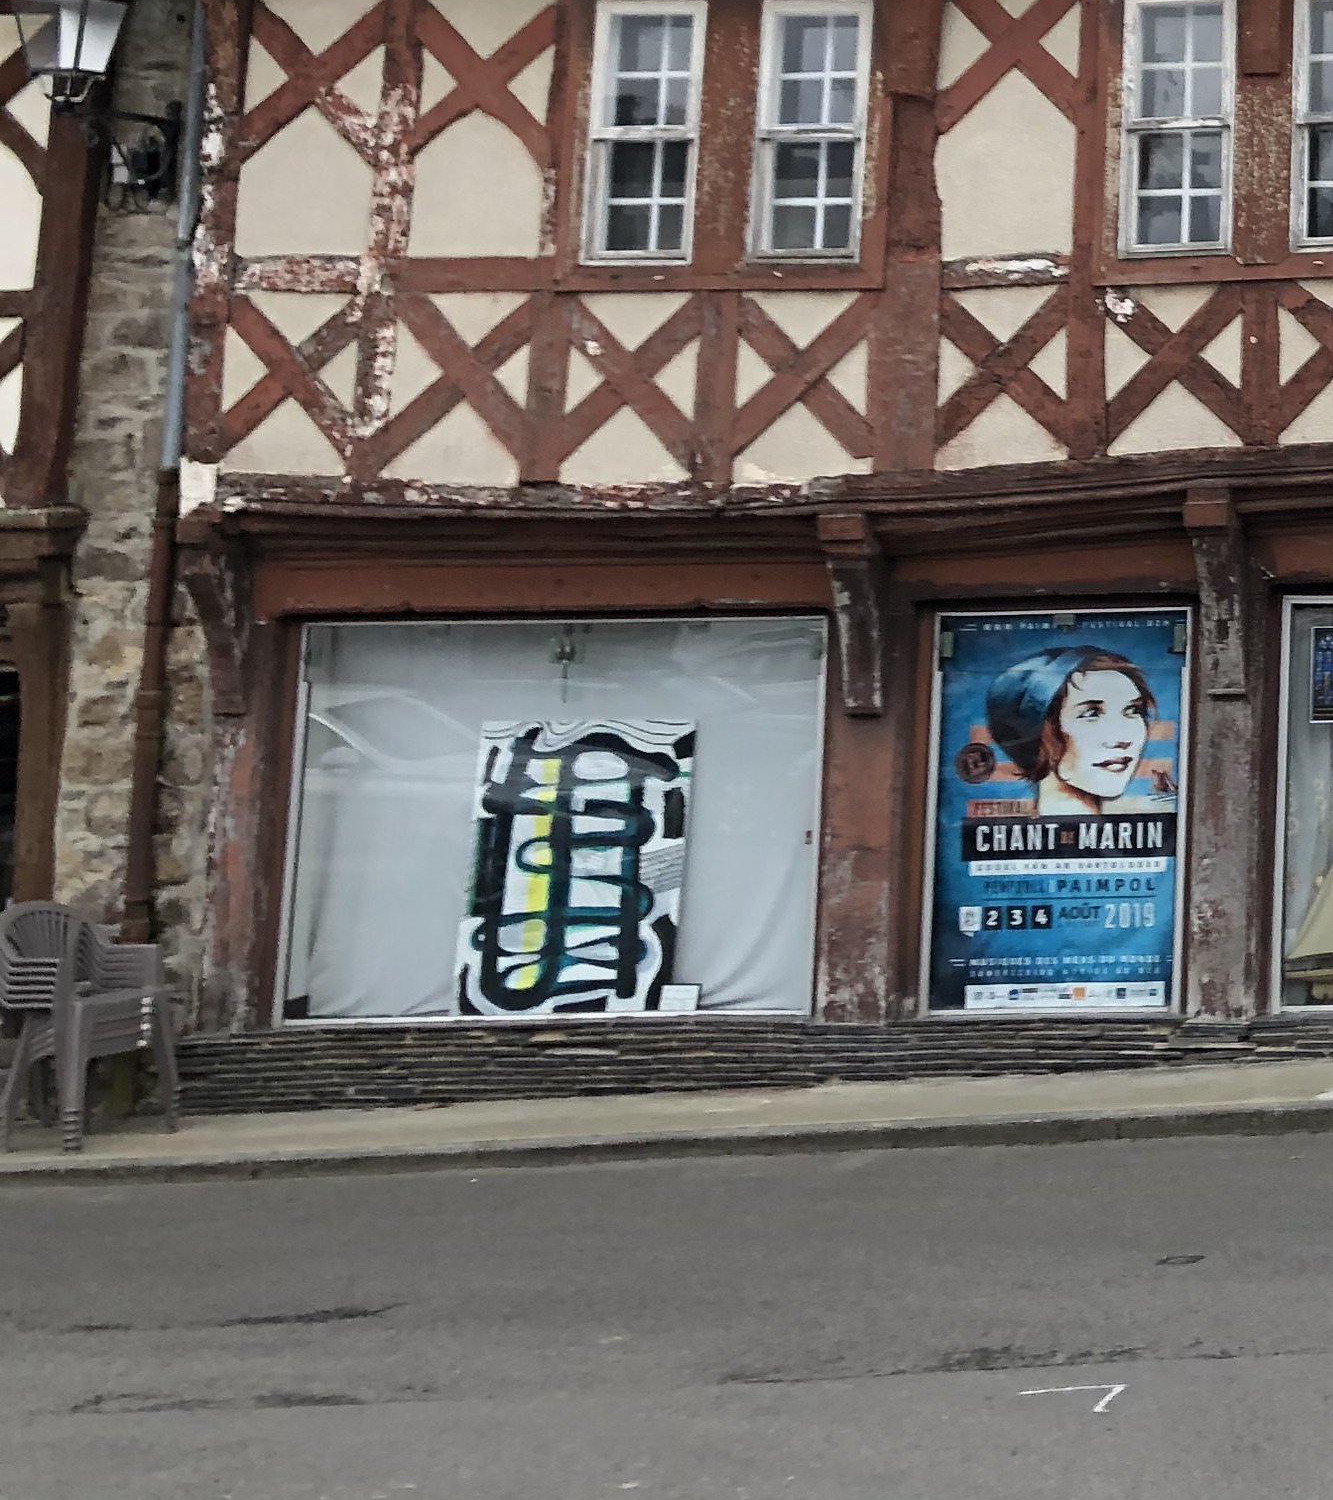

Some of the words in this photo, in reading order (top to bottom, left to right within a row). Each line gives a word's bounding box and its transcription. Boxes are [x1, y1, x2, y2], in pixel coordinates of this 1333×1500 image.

[975, 823, 1059, 852] CHANT
[1078, 821, 1163, 850] MARIN
[1056, 878, 1157, 893] PAIMPOL
[985, 910, 999, 926] 2
[1009, 909, 1023, 926] 3
[1034, 909, 1049, 925] 4
[1104, 902, 1156, 929] 2019
